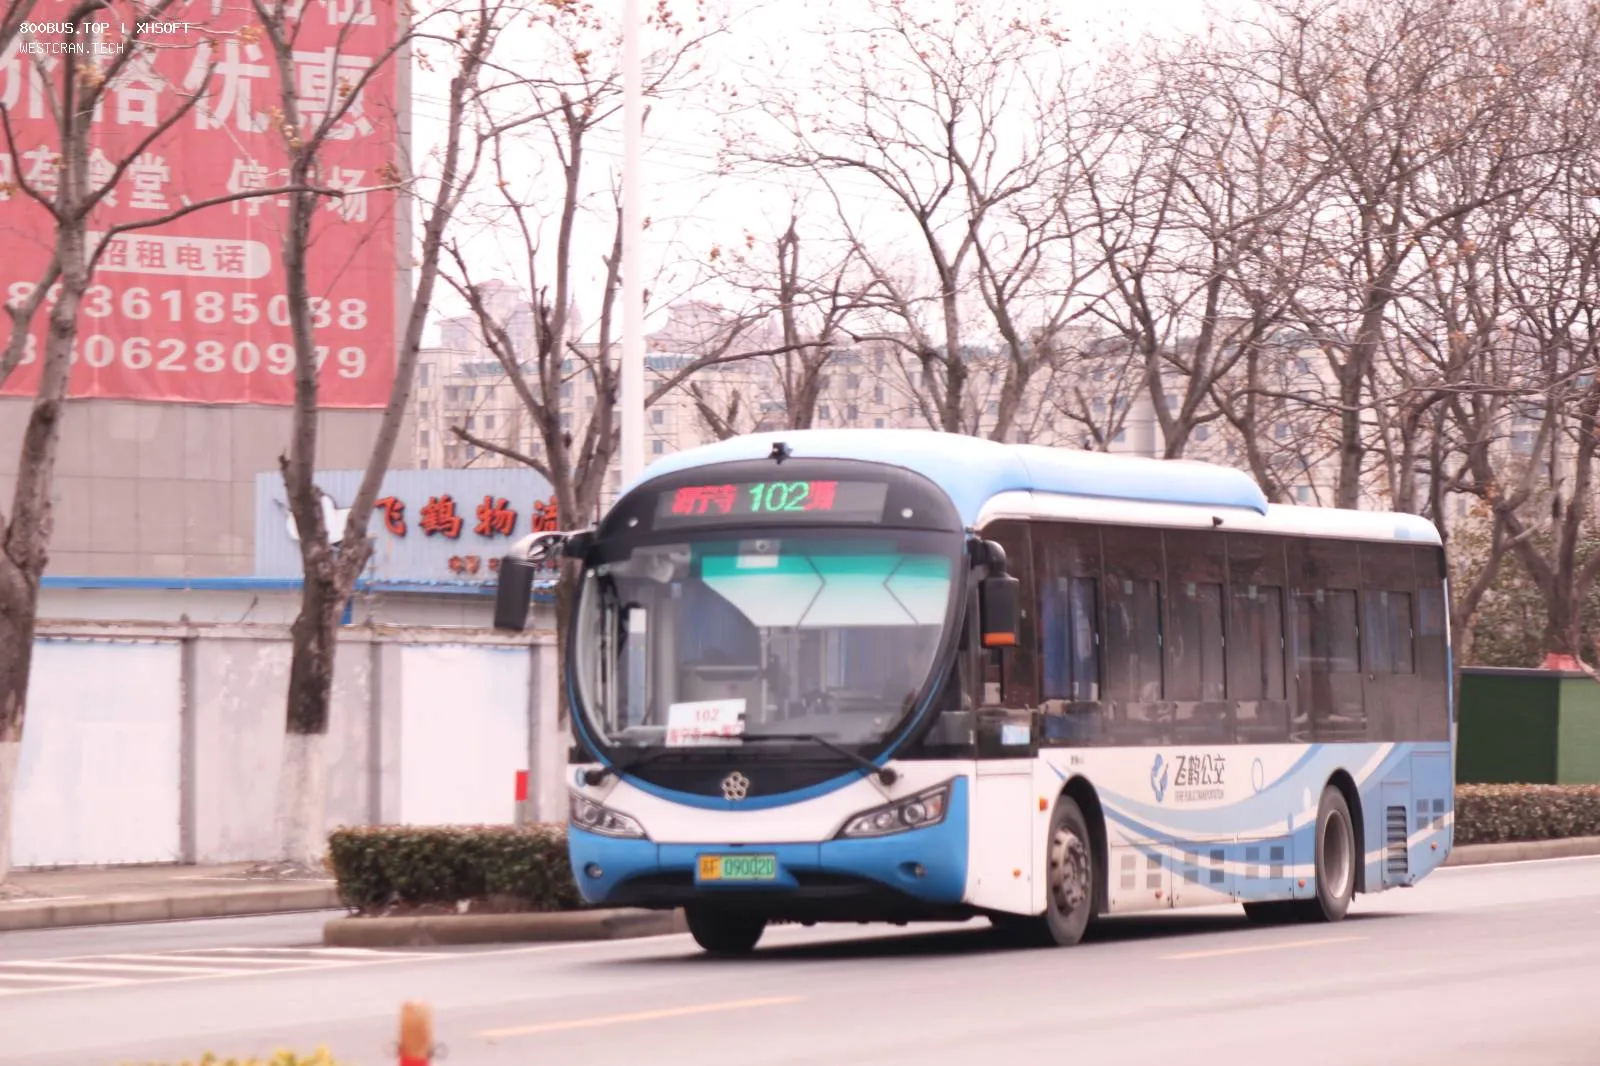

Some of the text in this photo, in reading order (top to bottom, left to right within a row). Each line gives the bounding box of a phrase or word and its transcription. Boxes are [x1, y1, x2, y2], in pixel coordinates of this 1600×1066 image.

[92, 239, 246, 274] 招租电话
[749, 481, 810, 512] 102
[695, 707, 721, 723] 102
[1174, 753, 1226, 786] 飞鹤公交
